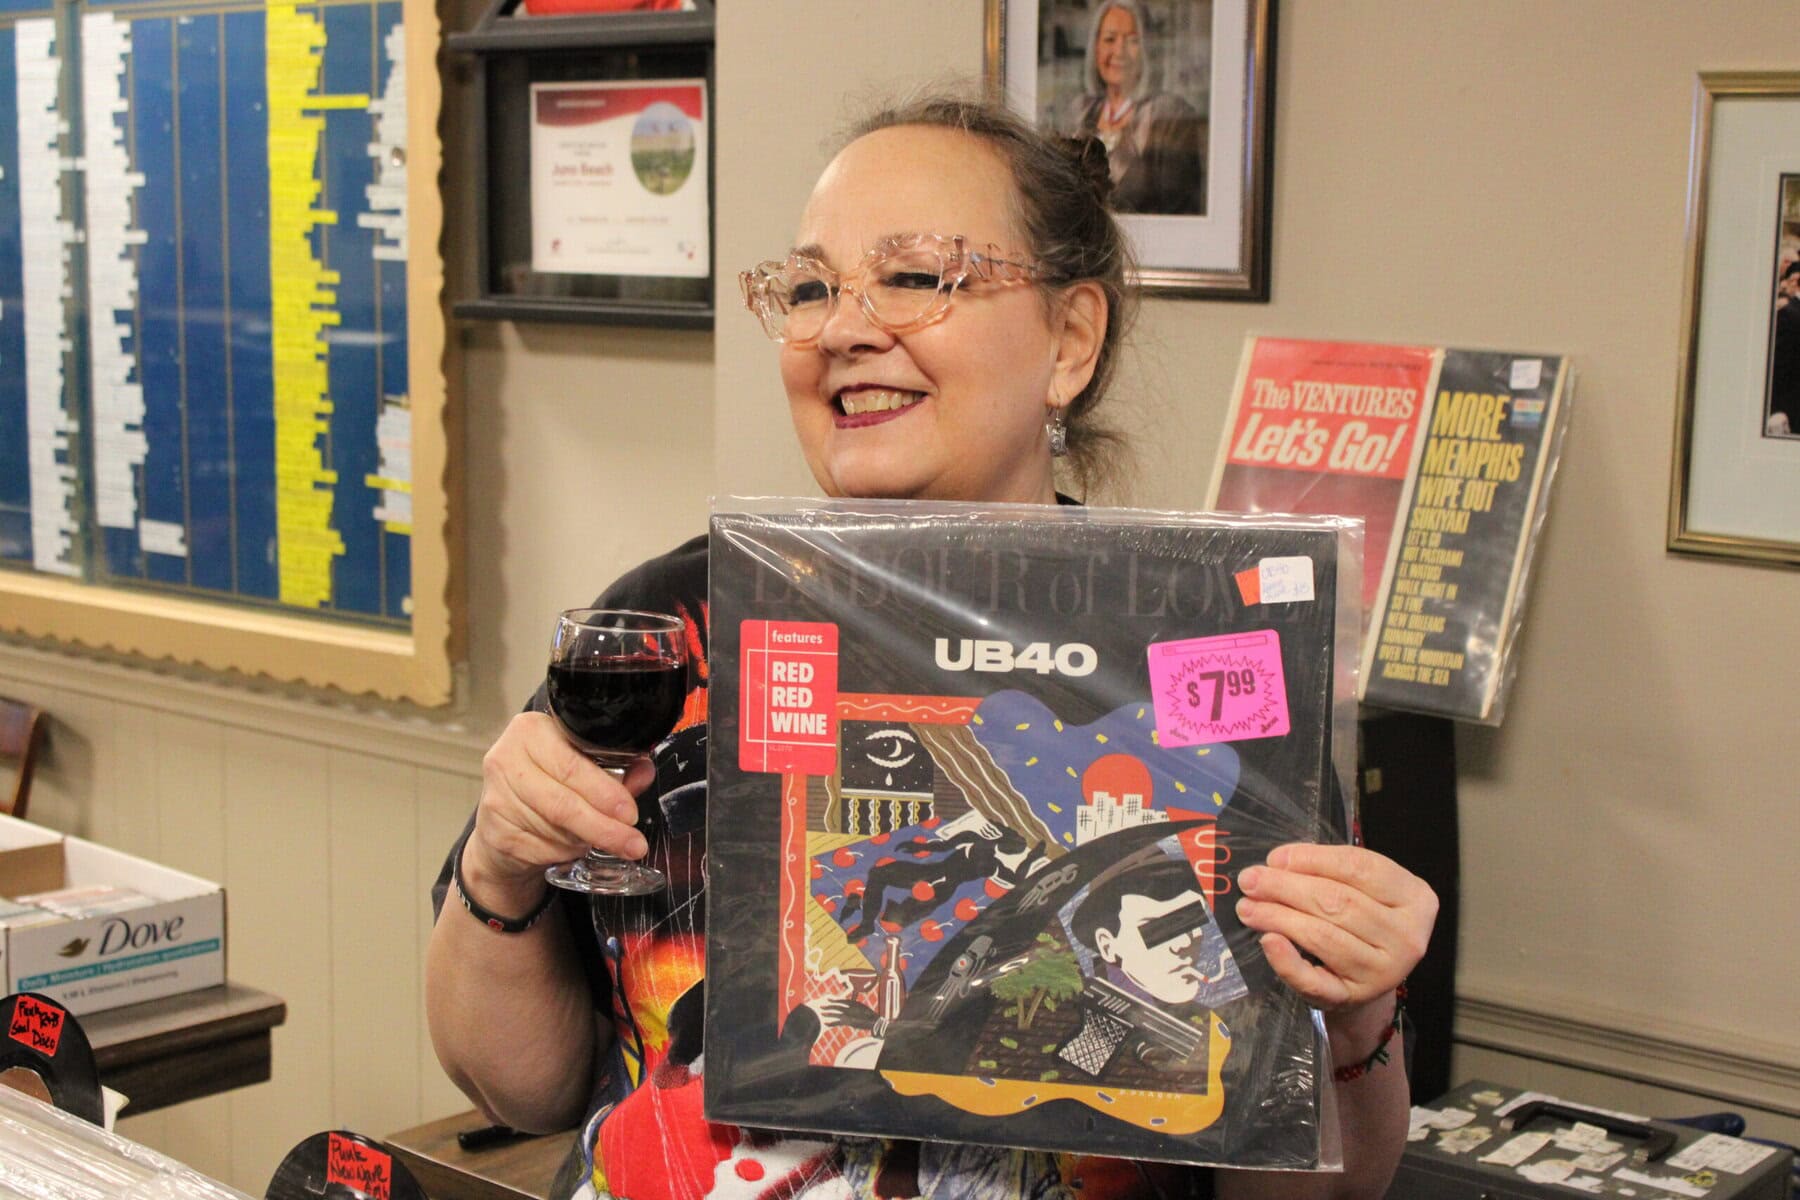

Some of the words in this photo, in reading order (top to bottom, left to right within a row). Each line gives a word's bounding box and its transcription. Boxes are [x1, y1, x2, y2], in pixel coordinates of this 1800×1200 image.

[1251, 378, 1290, 409] The
[1291, 380, 1416, 418] VENTURES
[1432, 391, 1510, 440] MORE
[1232, 413, 1331, 467] Let's
[1328, 421, 1408, 472] Go!
[1423, 438, 1524, 482] MEMPHIS
[1416, 475, 1464, 509] WIPE
[1462, 481, 1498, 512] OUT
[1410, 506, 1471, 534] SUKIYAKI
[771, 630, 823, 645] features
[772, 661, 814, 683] RED
[935, 638, 1098, 677] UB40
[771, 686, 813, 708] RED
[771, 712, 828, 735] WINE
[99, 915, 184, 957] Dove
[32, 1029, 56, 1049] Disco
[330, 1139, 368, 1162] Punk
